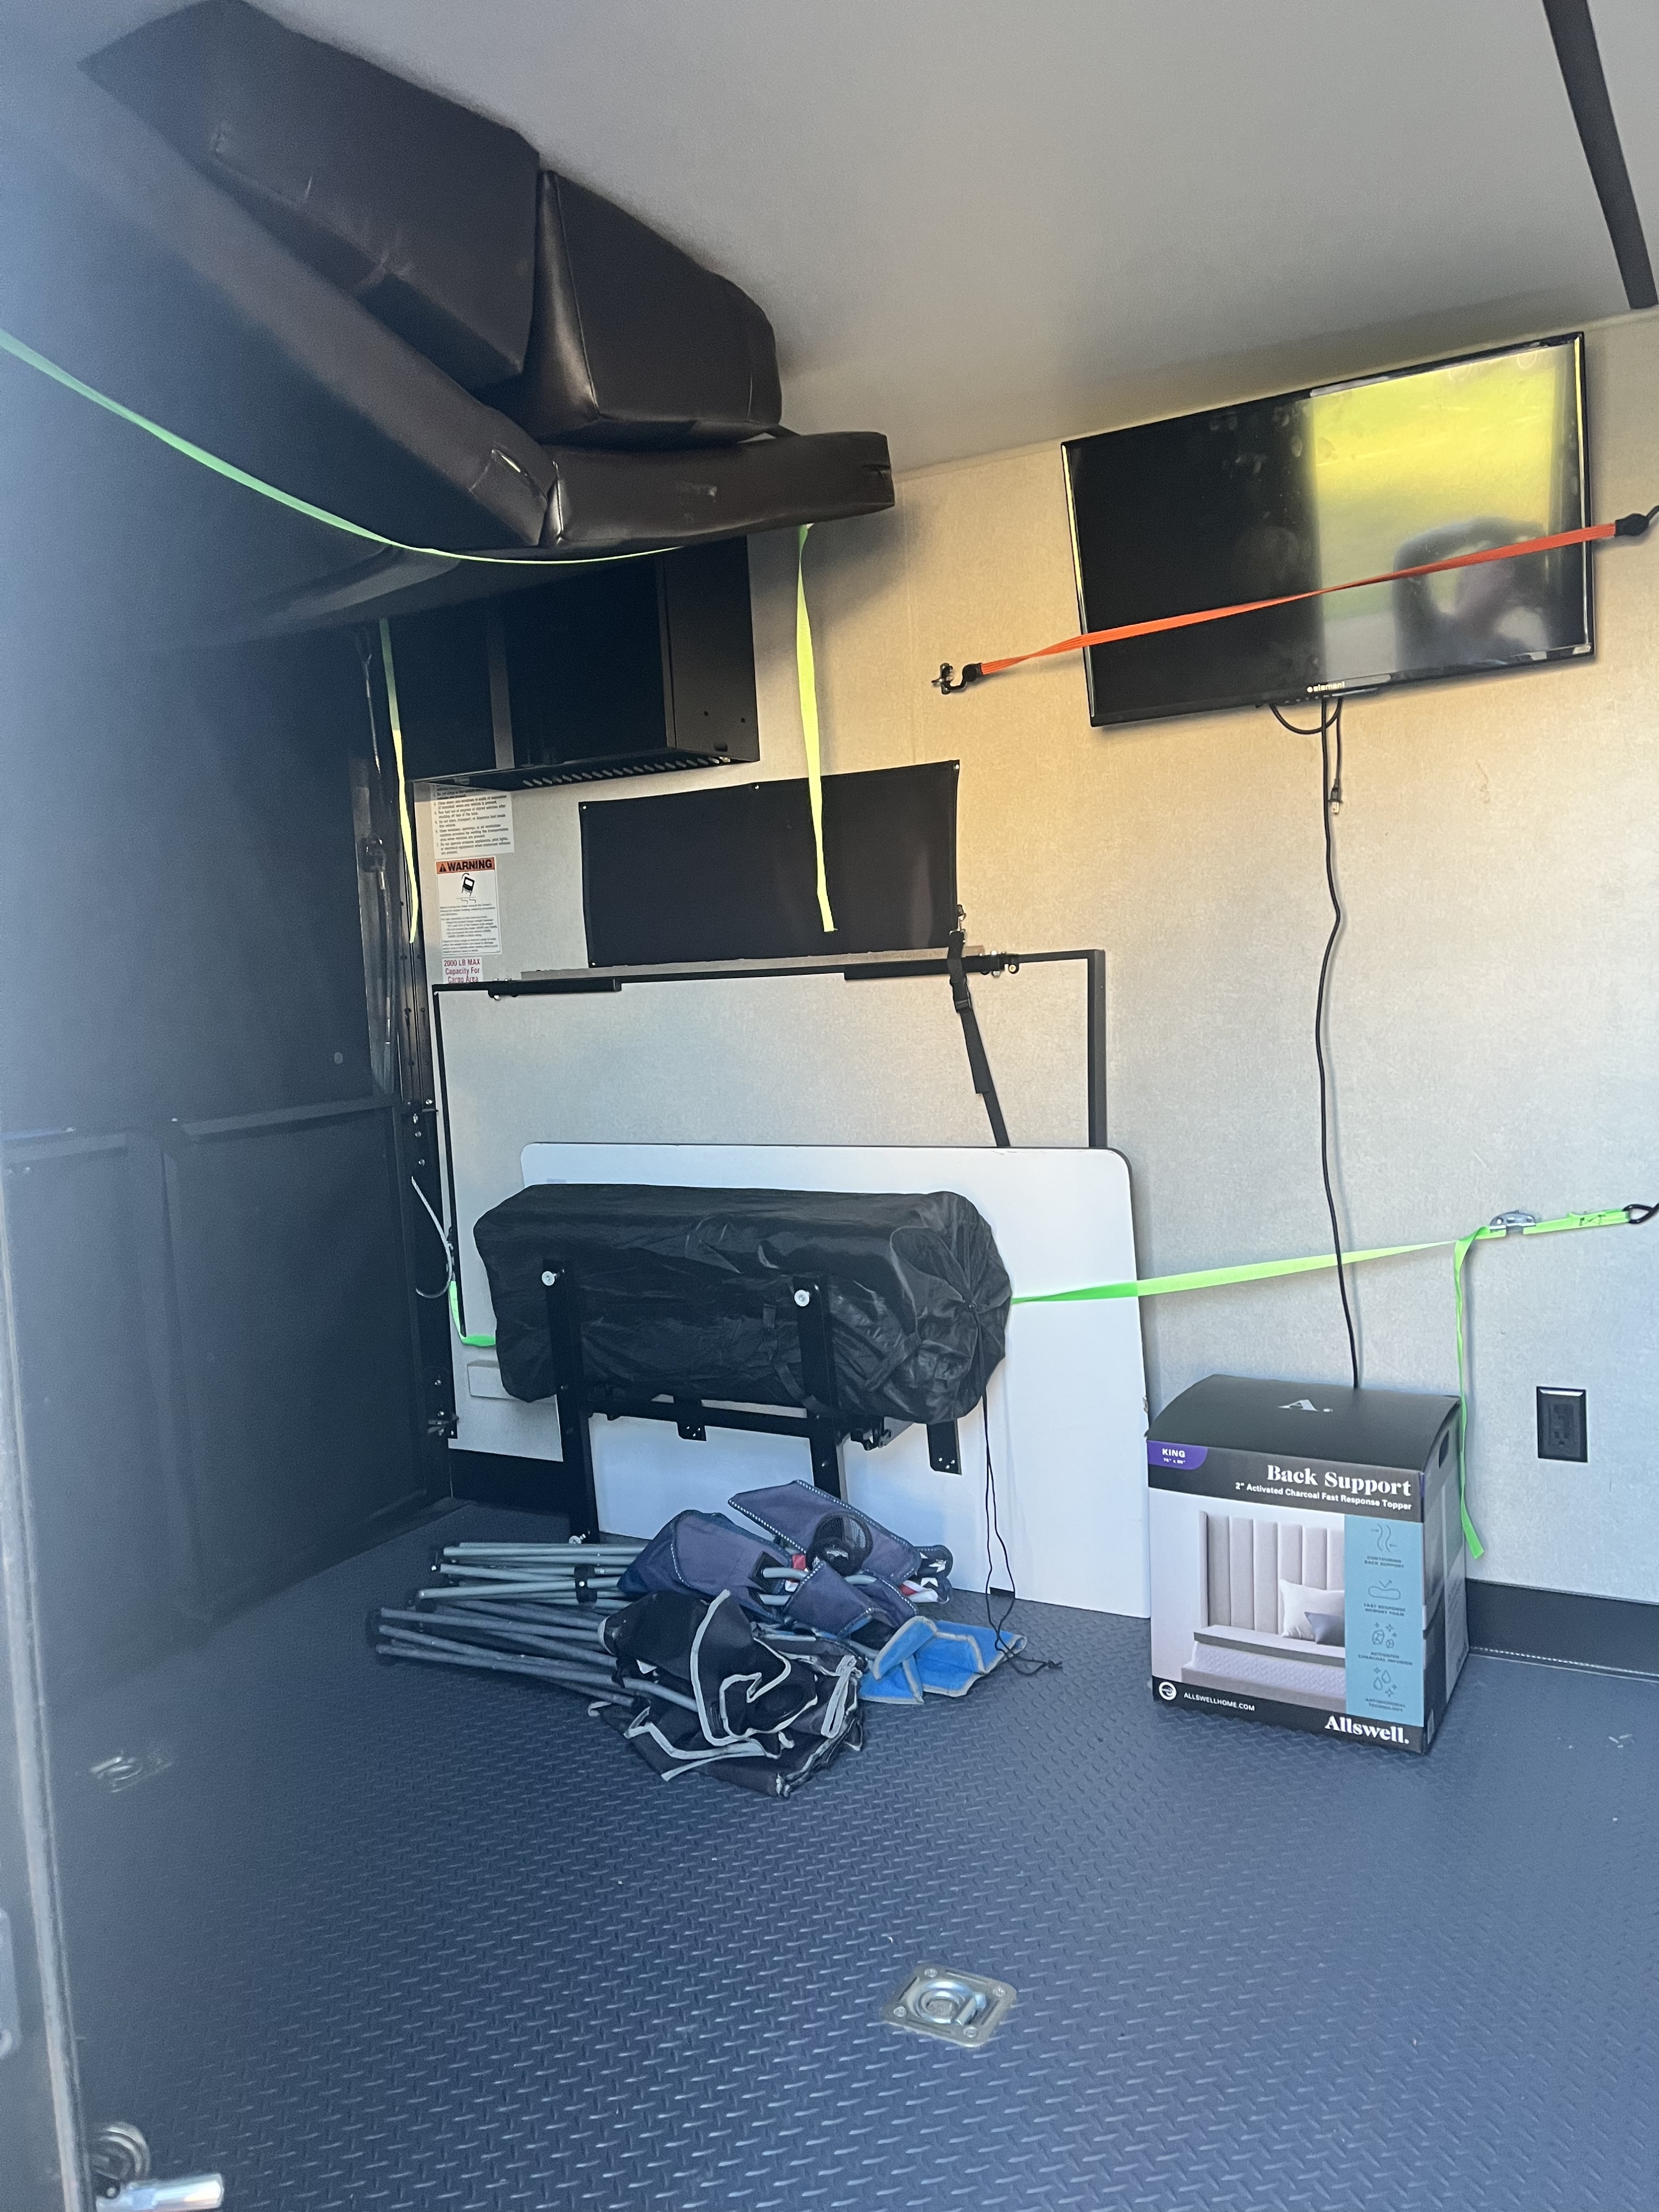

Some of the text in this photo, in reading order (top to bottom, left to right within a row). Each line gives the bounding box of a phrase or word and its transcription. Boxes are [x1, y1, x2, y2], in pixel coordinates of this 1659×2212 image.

[447, 859, 492, 871] WARNING
[445, 967, 469, 976] Capacity
[1162, 1448, 1186, 1458] KING
[1267, 1464, 1411, 1496] Back Support
[1235, 1482, 1412, 1510] 2" Activated Charcoal Fast Response Topper
[1184, 1692, 1255, 1712] ALLSWELLHOME.COM
[1325, 1715, 1410, 1744] Allswell.
